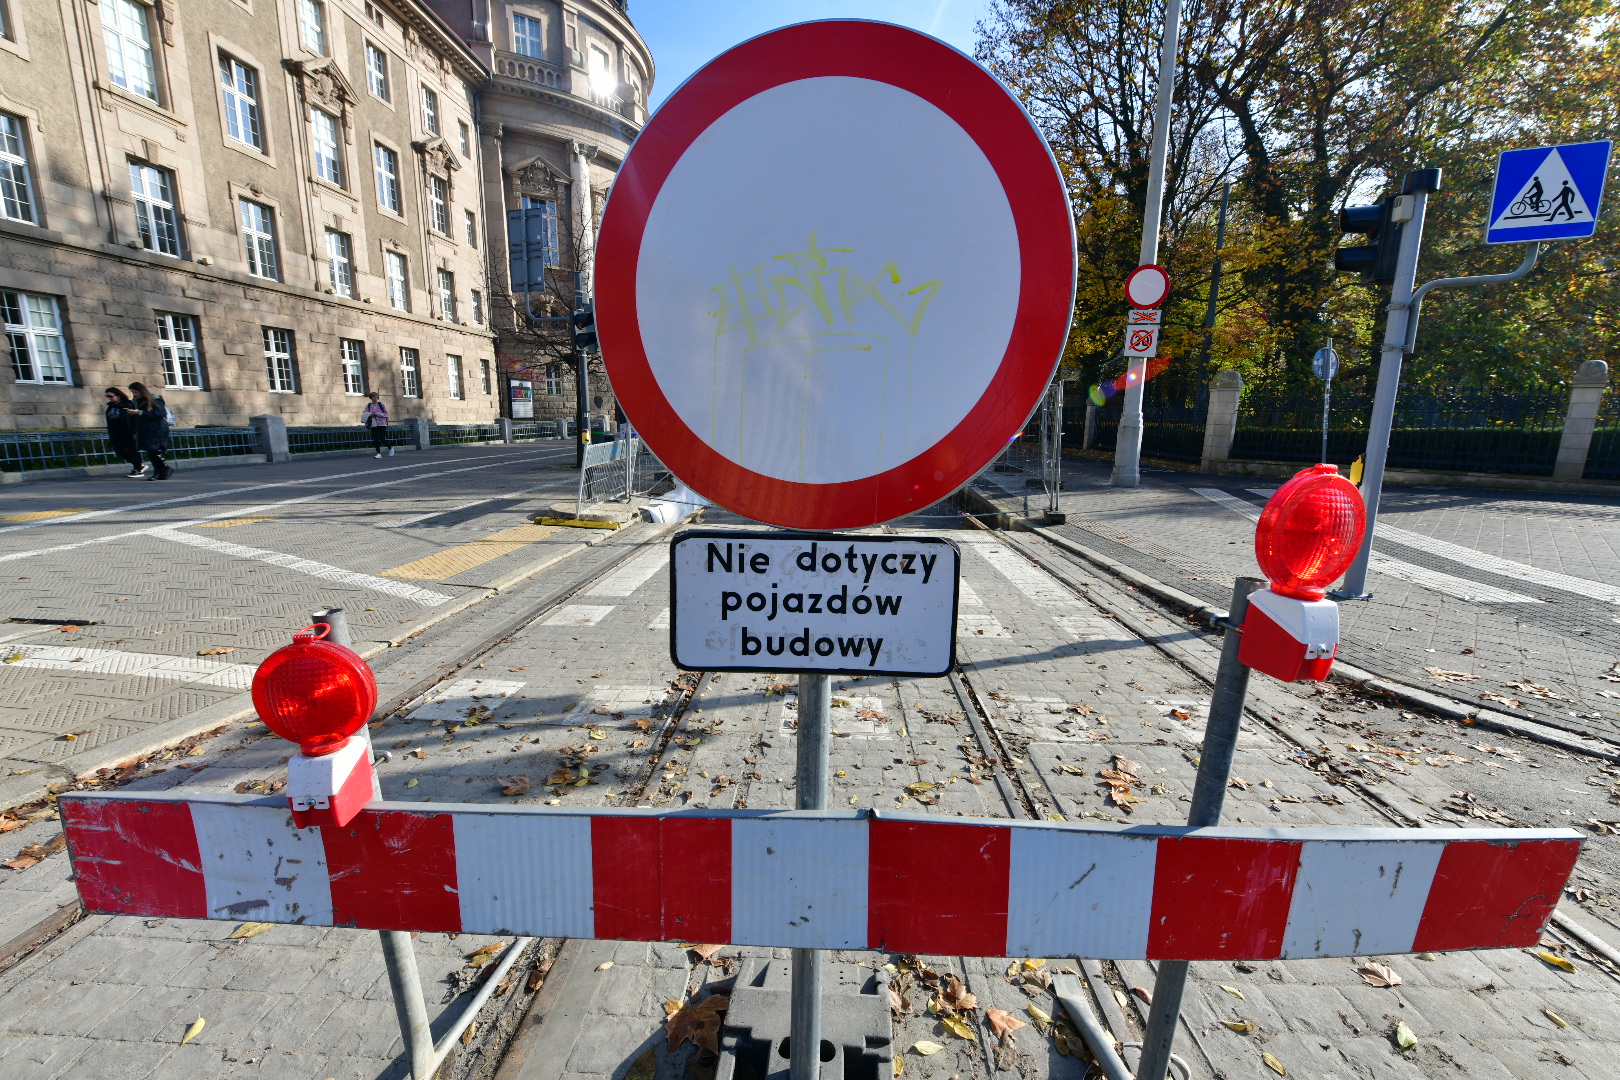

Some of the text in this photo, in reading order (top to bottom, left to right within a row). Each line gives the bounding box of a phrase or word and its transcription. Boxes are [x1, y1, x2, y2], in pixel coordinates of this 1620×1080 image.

[706, 542, 938, 585] Nie dotyczy
[721, 583, 903, 622] pojazdów
[741, 626, 884, 667] budowy
